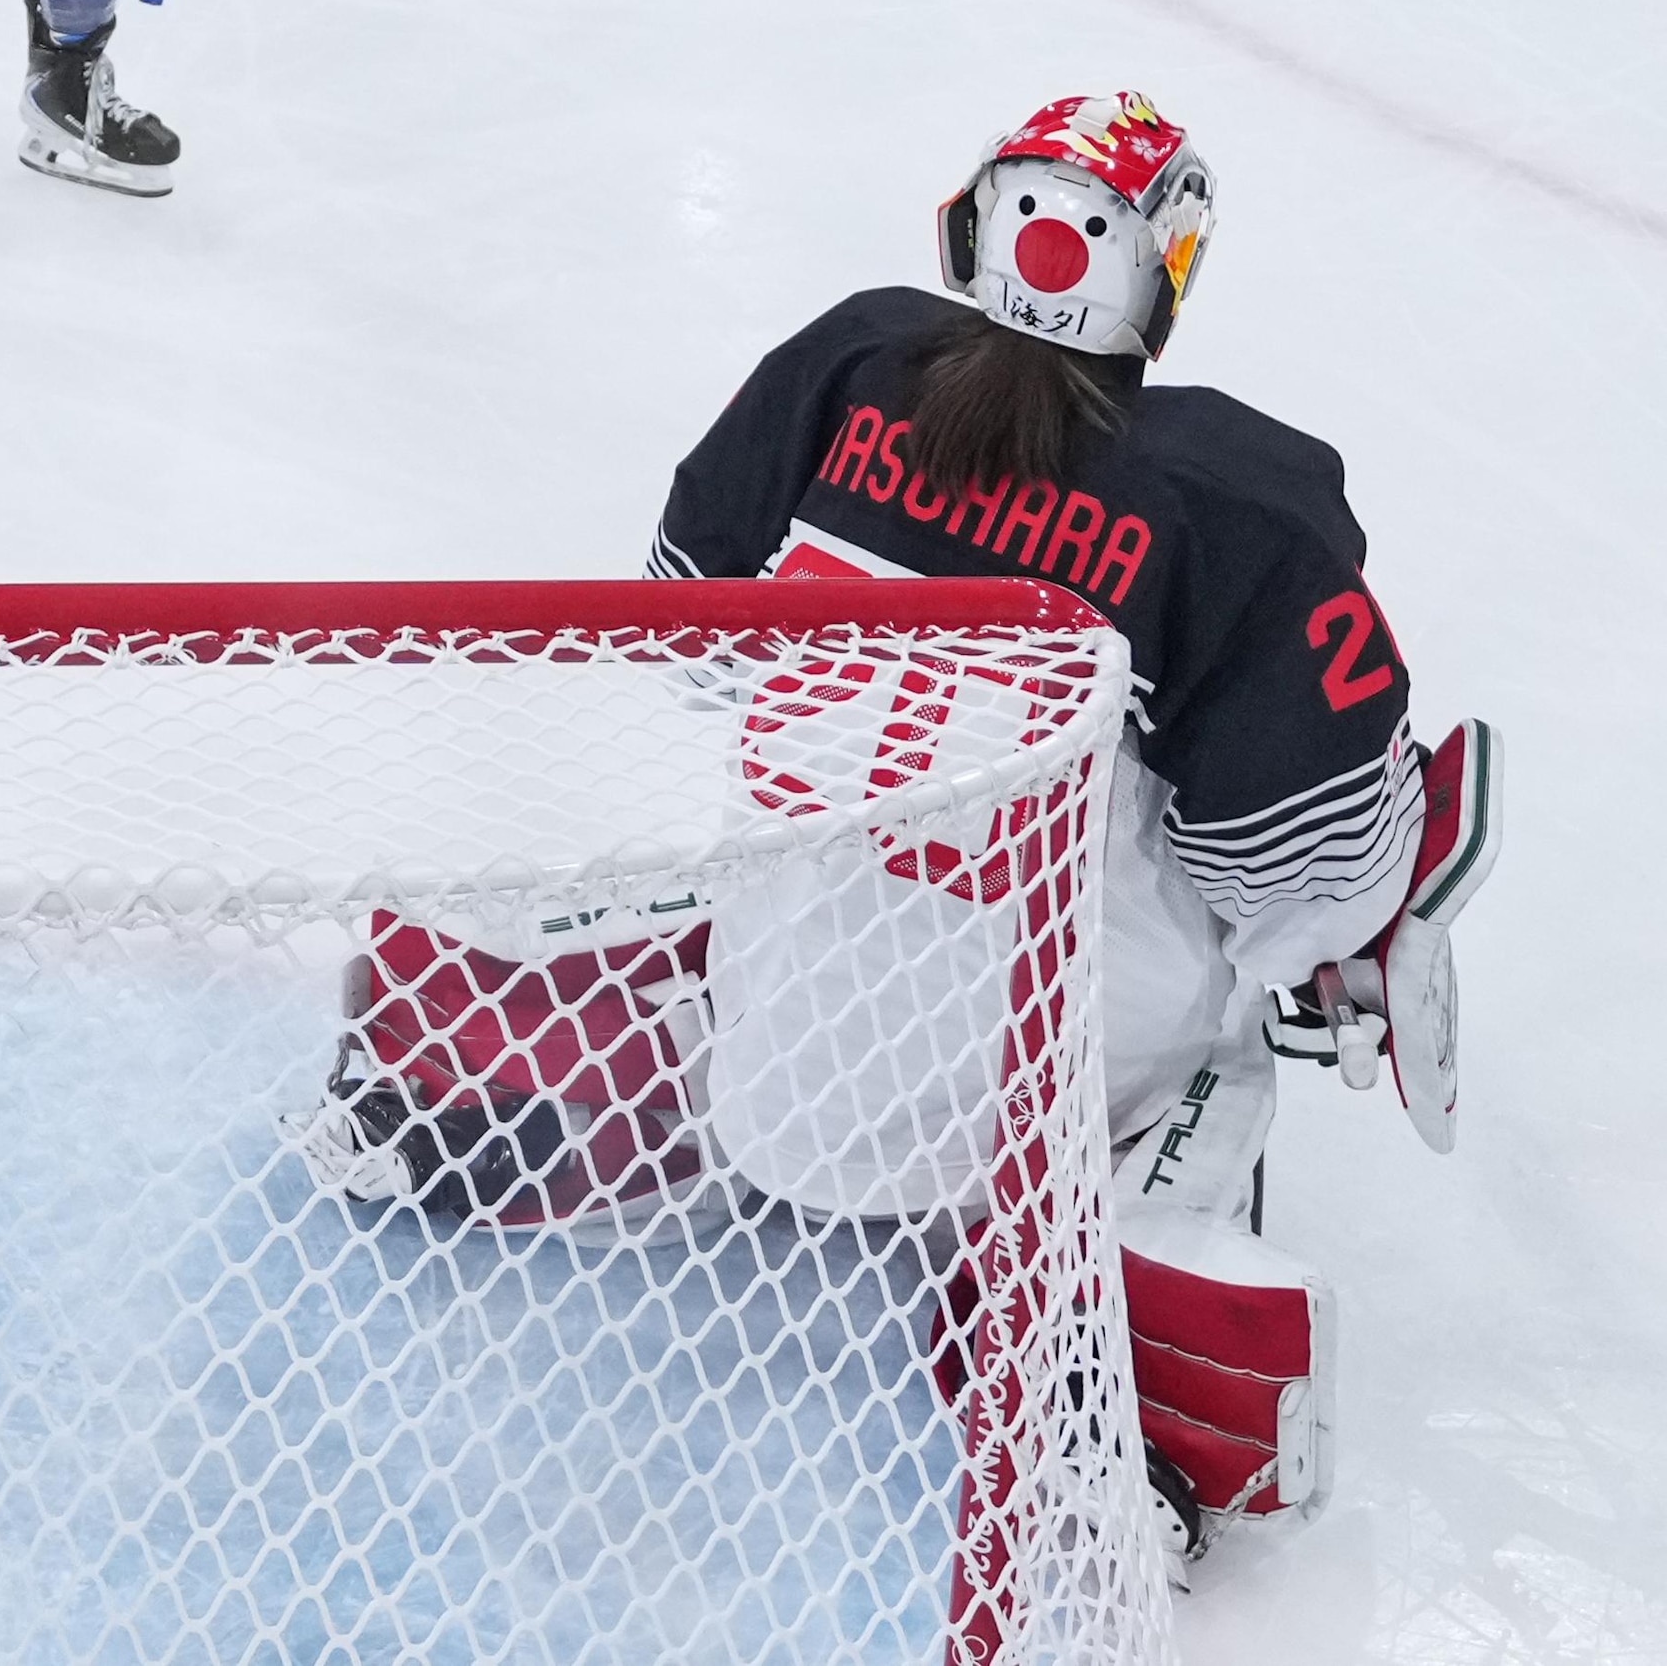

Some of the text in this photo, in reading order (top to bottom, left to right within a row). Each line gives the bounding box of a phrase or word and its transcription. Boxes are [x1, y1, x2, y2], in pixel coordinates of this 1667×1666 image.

[818, 404, 1153, 607] ASUHARA
[1305, 560, 1405, 713] 2
[1141, 1067, 1220, 1195] TRUE
